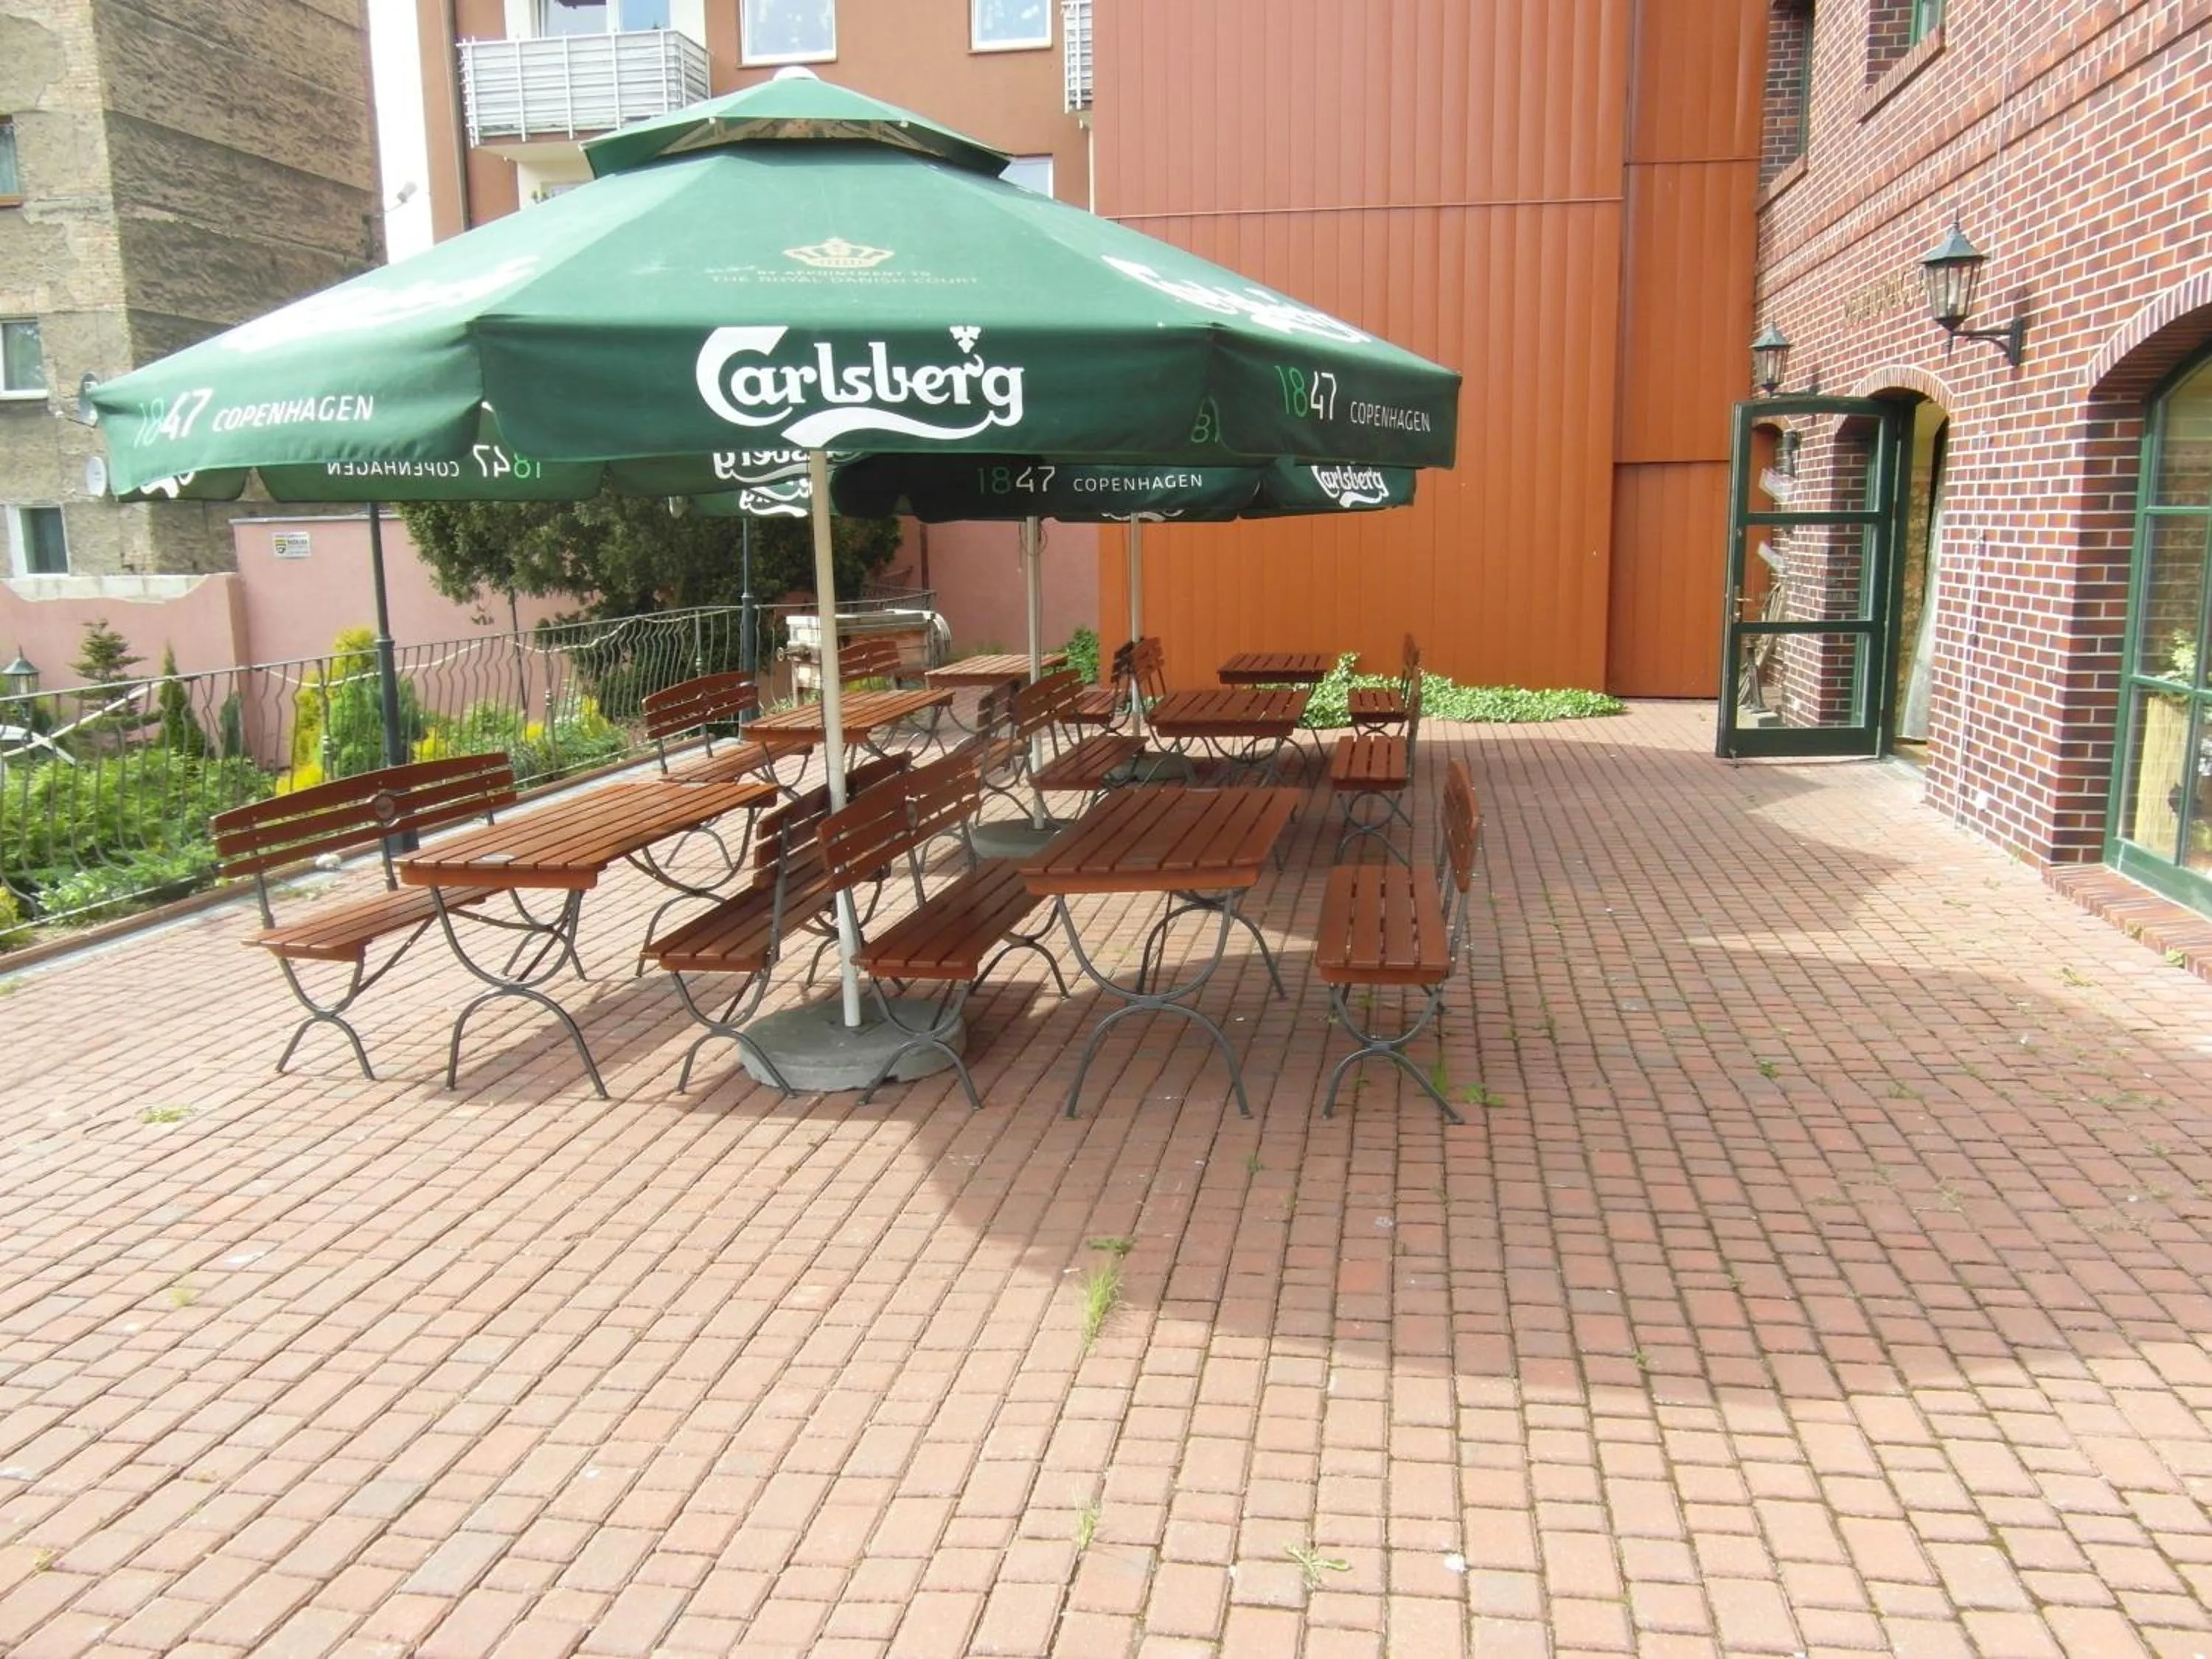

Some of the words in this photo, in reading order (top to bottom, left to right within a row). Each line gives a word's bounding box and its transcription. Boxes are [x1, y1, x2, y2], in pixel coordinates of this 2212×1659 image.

[695, 325, 1024, 428] Carlsberg
[1274, 365, 1338, 420] 1847
[1349, 400, 1430, 433] COPENHAGEN
[133, 388, 213, 448] 1847
[212, 394, 374, 433] COPENHAGEN
[978, 465, 1056, 494] 1847
[1073, 473, 1203, 492] COPENHAGEN
[1310, 465, 1389, 499] Carlsberg
